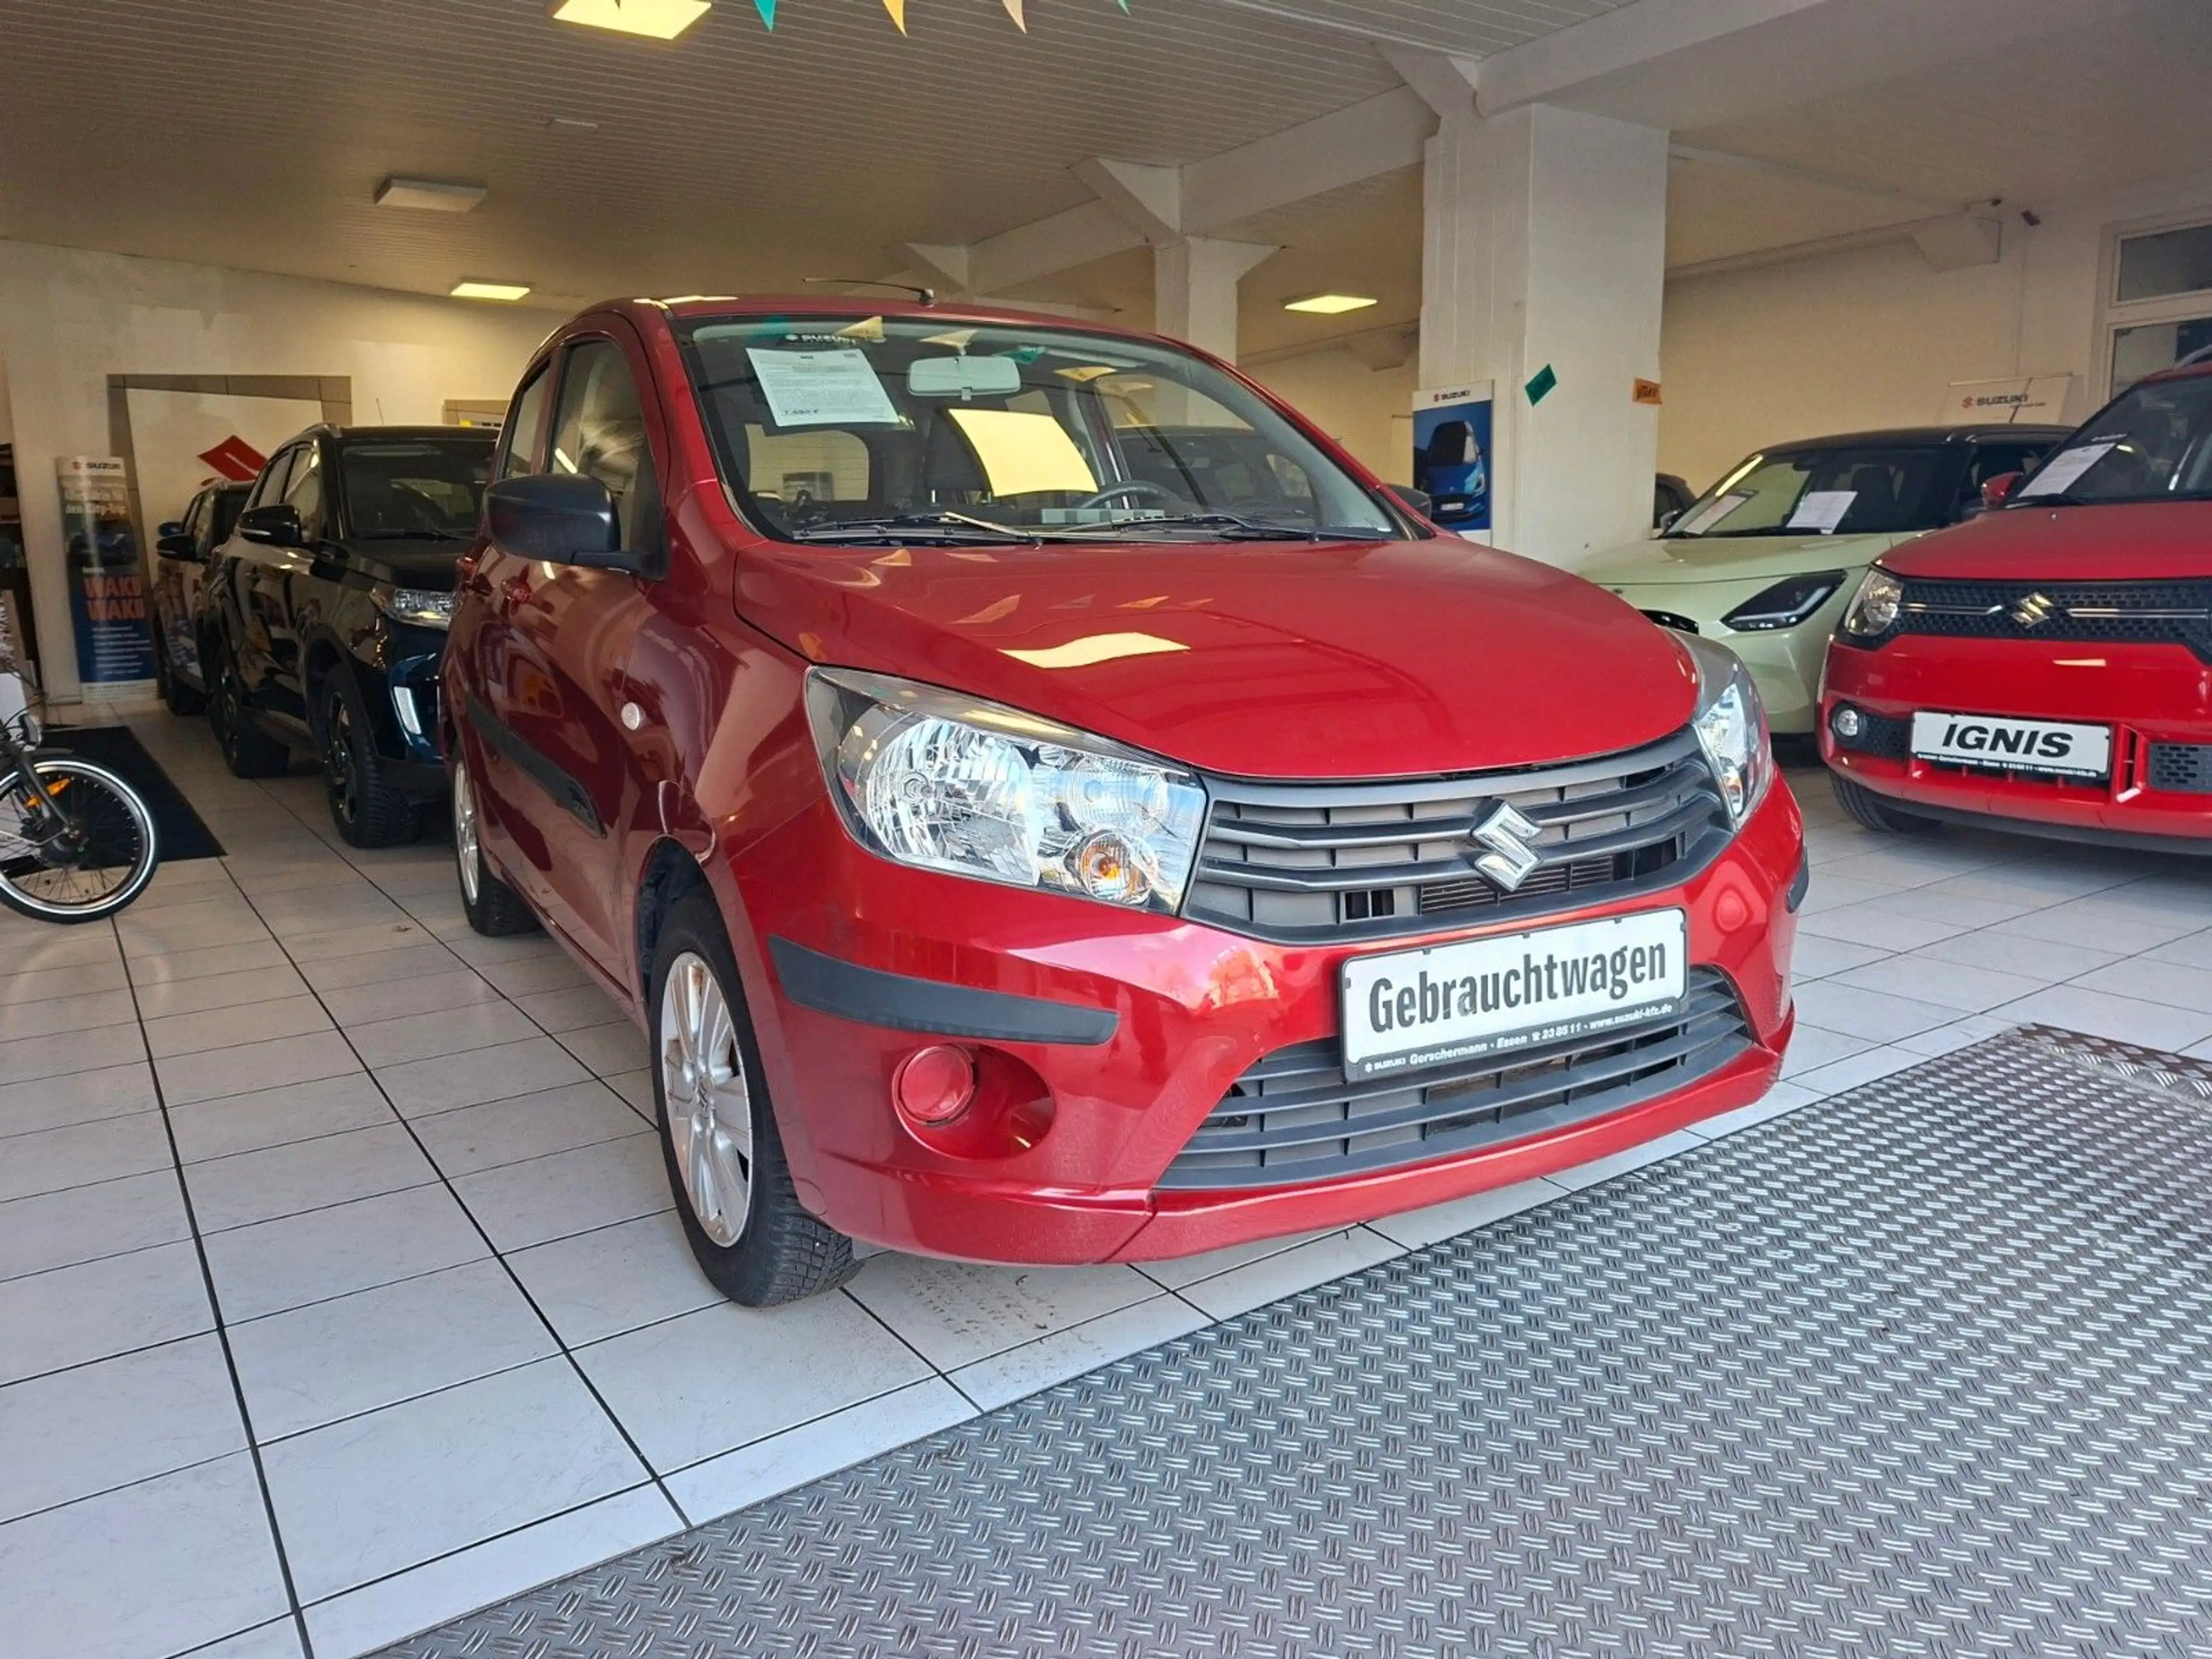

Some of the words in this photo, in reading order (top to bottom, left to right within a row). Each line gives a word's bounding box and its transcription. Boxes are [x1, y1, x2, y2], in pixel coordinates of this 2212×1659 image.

[1441, 390, 1471, 400] SUZUKI
[1976, 393, 2028, 406] SUZUKI
[1942, 724, 2074, 758] IGNIS
[1369, 942, 1666, 1033] Gebrauchtwagen
[1374, 1058, 1406, 1070] SUZUKI
[1496, 1035, 1528, 1049] Essen
